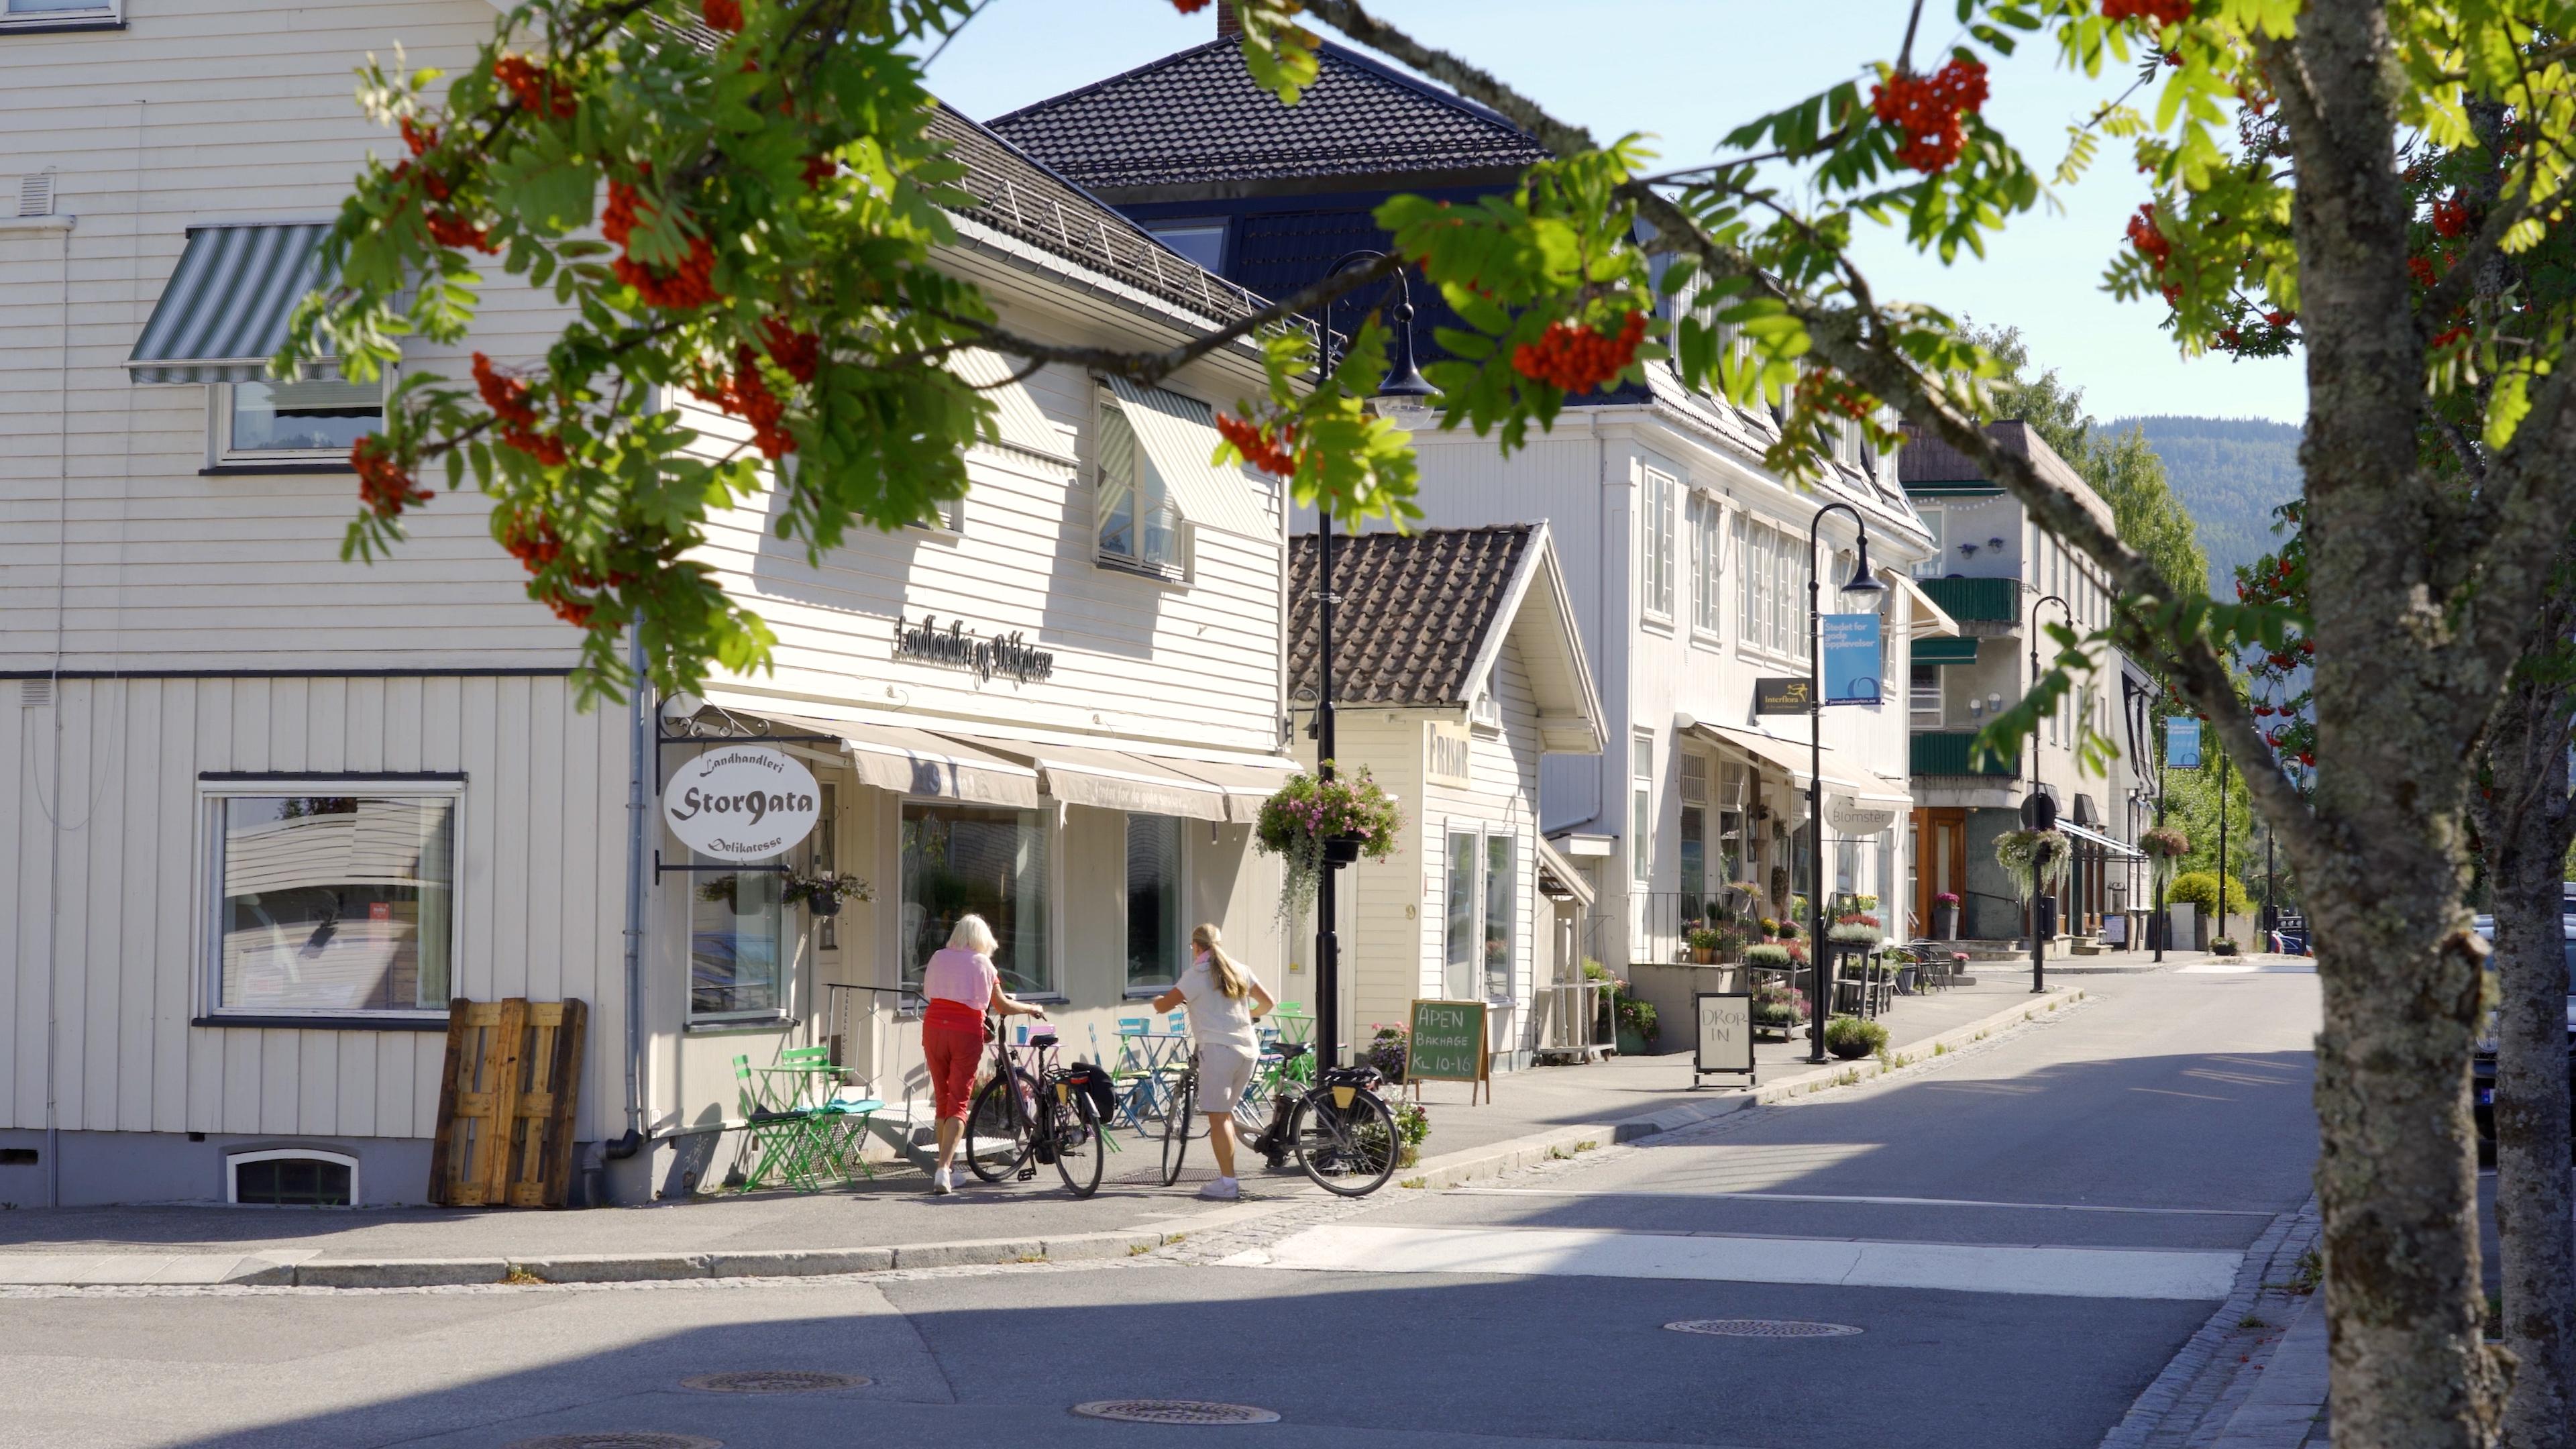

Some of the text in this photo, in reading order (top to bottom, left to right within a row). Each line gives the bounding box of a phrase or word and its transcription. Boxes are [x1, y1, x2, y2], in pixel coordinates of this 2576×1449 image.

[1825, 621, 1868, 631] Stedet for
[1825, 631, 1847, 642] gode
[1825, 638, 1876, 650] opplevelser
[976, 642, 991, 683] og
[994, 631, 1053, 684] Delikatesse
[1765, 695, 1799, 703] Interflora
[700, 753, 785, 777] Landhandleri
[1833, 809, 1886, 823] Blomster
[708, 837, 782, 854] Delikatesse
[1405, 904, 1416, 920] 9
[1418, 1004, 1464, 1028] ÅPEN
[1711, 1028, 1729, 1042] IN
[1436, 1055, 1471, 1072] 10-16
